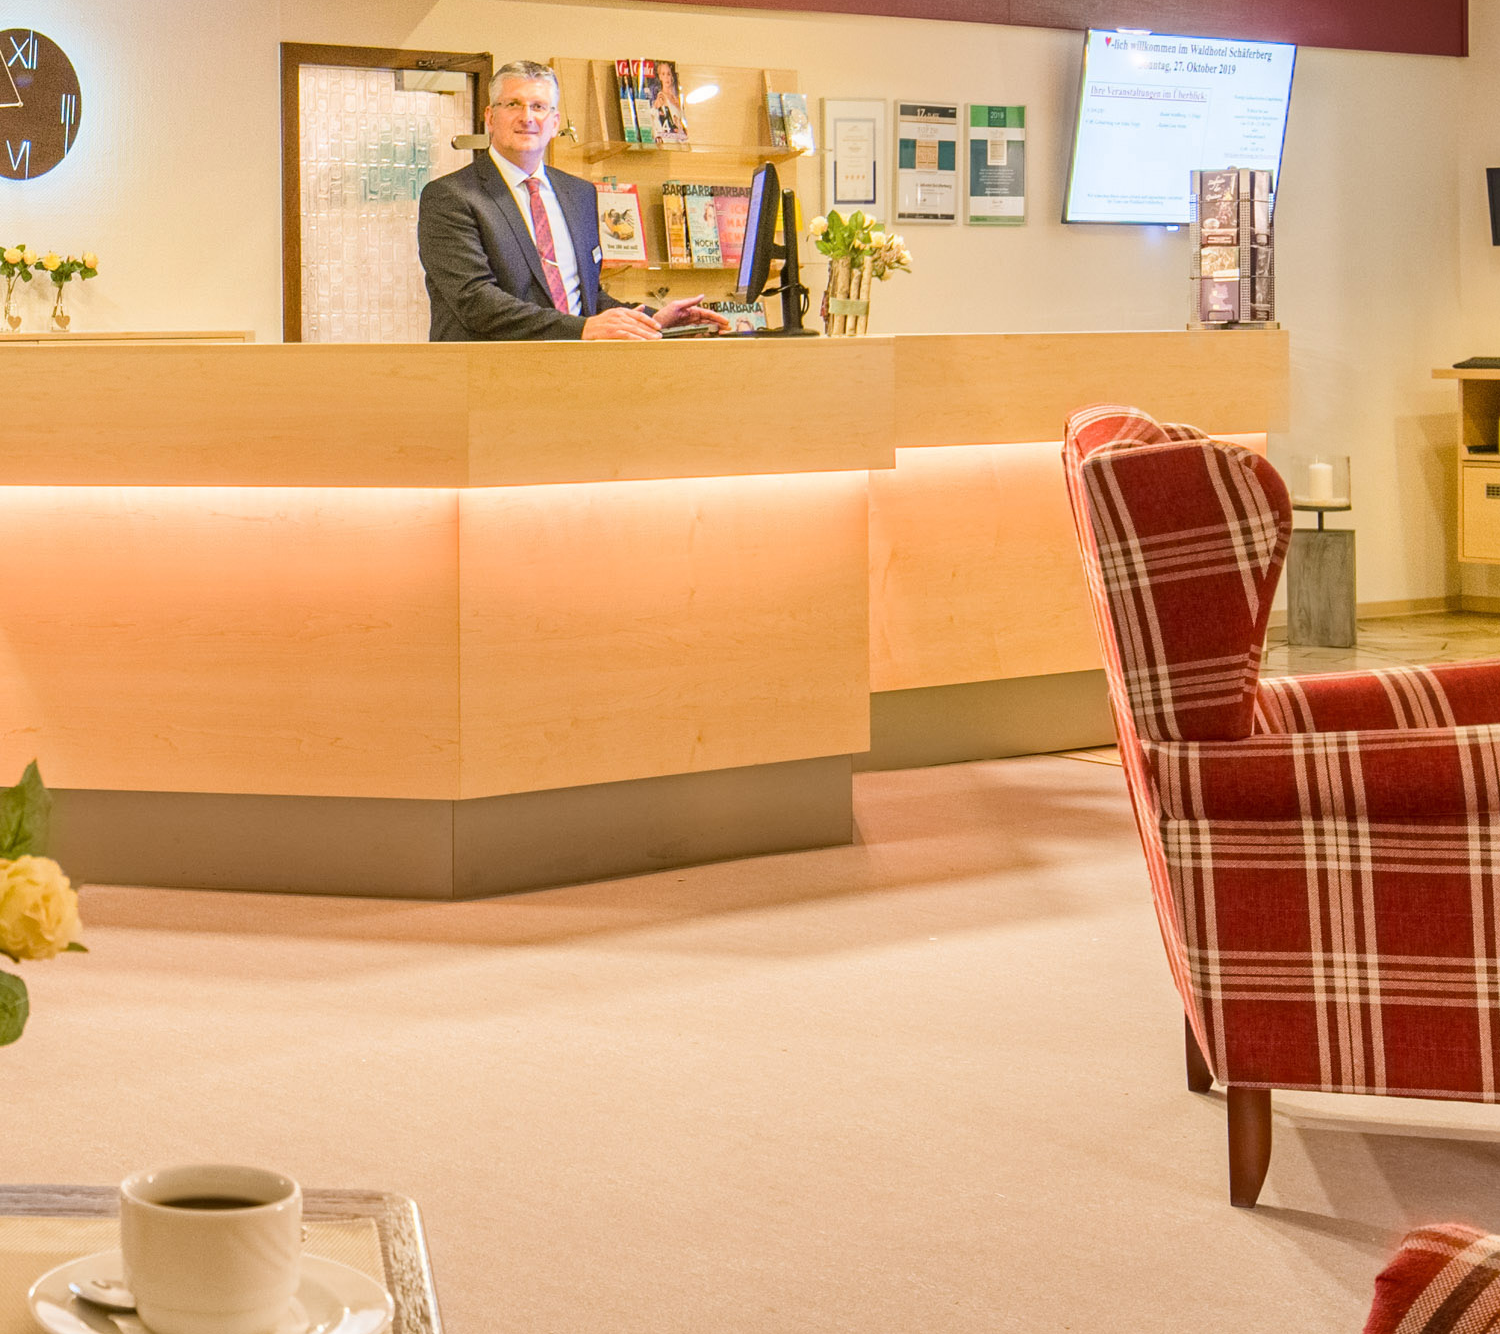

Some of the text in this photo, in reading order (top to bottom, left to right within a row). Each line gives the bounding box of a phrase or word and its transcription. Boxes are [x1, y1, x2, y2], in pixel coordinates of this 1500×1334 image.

[1131, 41, 1176, 53] willkommen
[1178, 44, 1188, 54] im
[1191, 44, 1227, 57] Waldhotel
[1229, 47, 1272, 62] Schäferberg
[1174, 61, 1184, 71] 27.
[1187, 62, 1217, 74] Oktober
[1219, 64, 1236, 74] 2019
[1091, 85, 1106, 95] Ihre
[1107, 86, 1161, 98] Veranstaltungen
[1162, 89, 1171, 98] im
[717, 301, 763, 313] BARBARA
